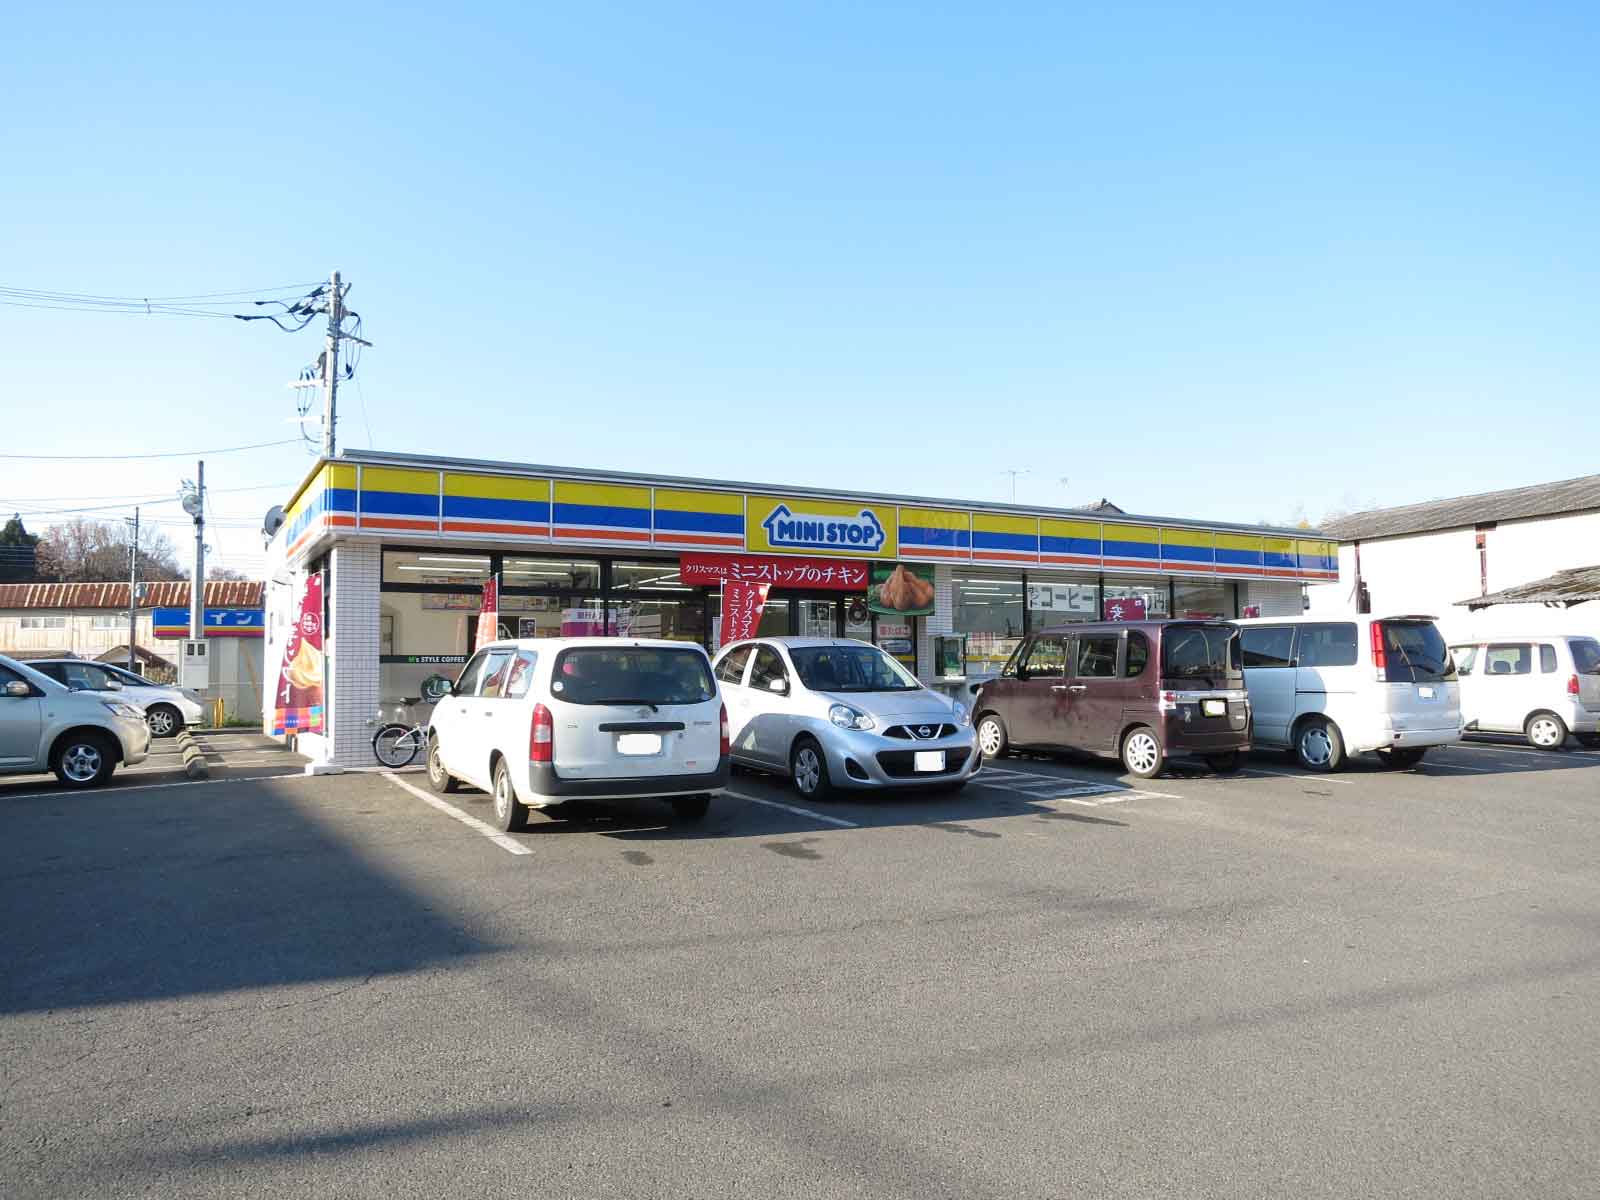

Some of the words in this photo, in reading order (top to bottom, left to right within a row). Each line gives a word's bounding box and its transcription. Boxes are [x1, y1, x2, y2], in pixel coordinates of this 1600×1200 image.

[778, 520, 875, 544] MINISTOP
[730, 563, 865, 584] ミニストップのチキン
[740, 590, 755, 639] クリスマス
